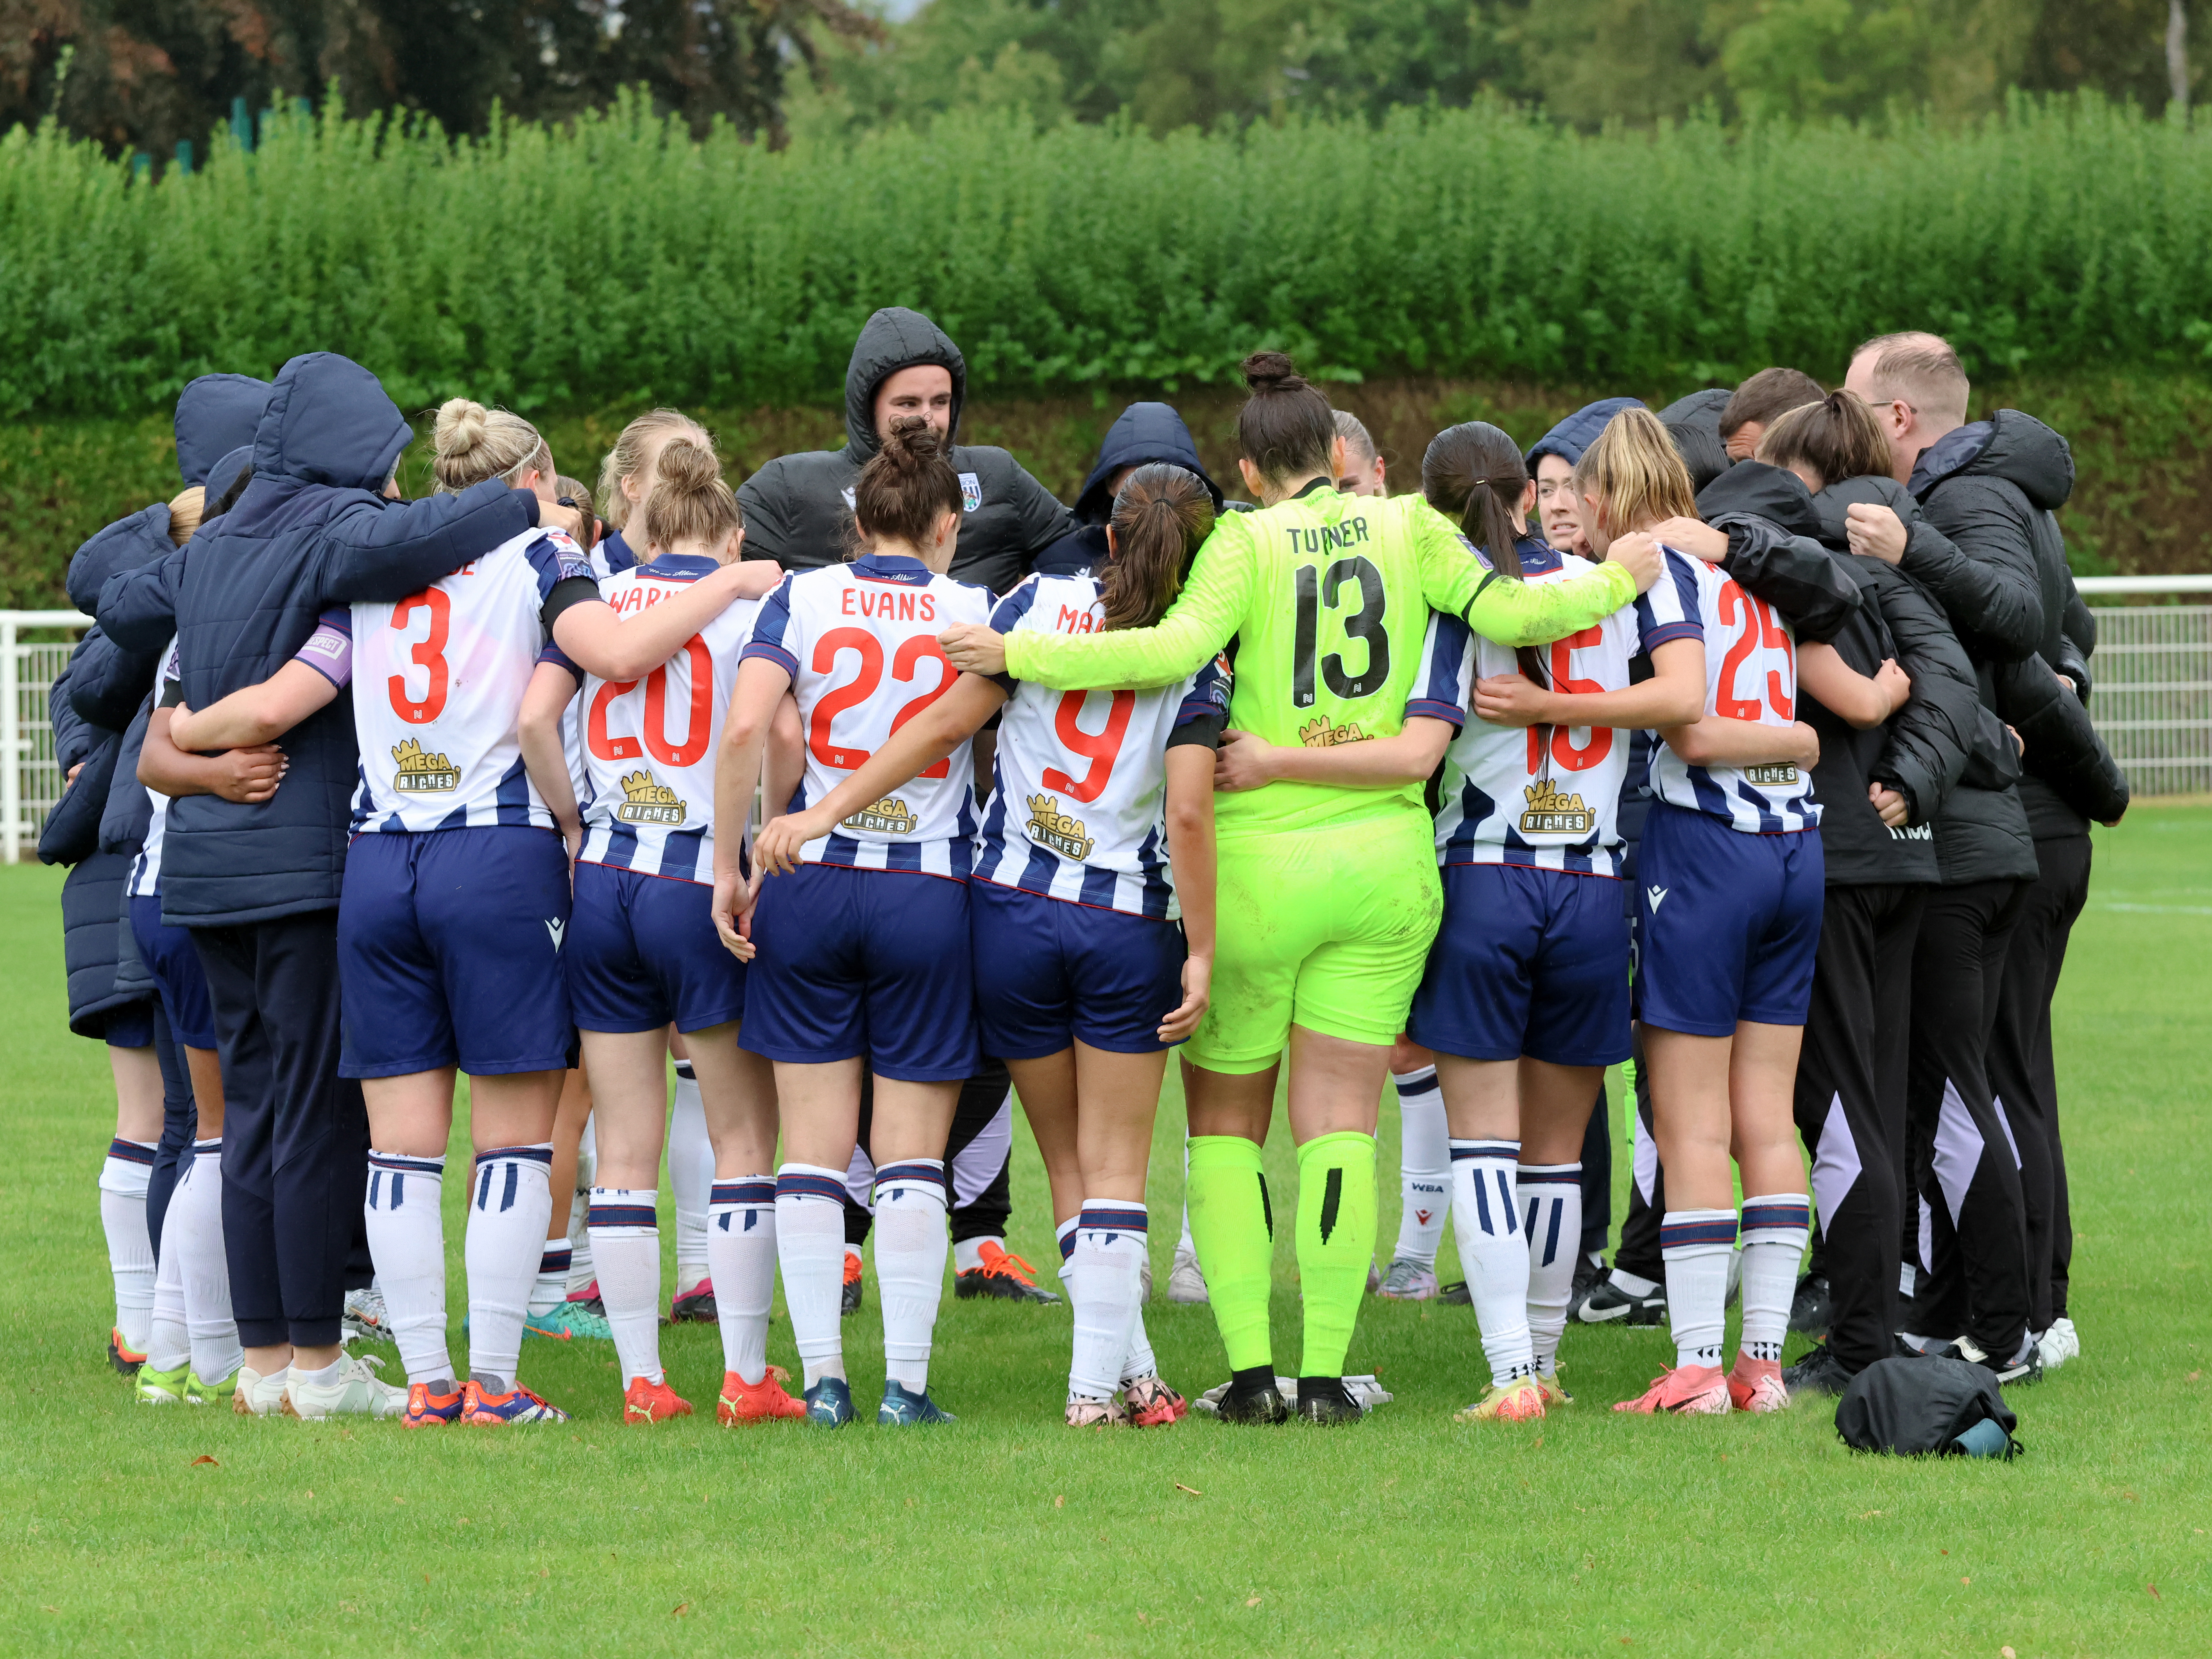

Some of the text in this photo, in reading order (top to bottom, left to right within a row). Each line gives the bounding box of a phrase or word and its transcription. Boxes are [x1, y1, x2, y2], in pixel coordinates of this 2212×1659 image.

[1286, 517, 1369, 555] TURNER
[842, 588, 935, 621] EVANS
[1293, 556, 1389, 708] 13
[307, 636, 339, 651] RESPECT
[1716, 579, 1793, 721] 25
[388, 586, 450, 724] 3
[809, 627, 957, 779] 22
[1305, 723, 1363, 747] MEGA
[1042, 690, 1135, 803] 9
[400, 753, 452, 771] MEGA
[400, 774, 453, 789] RICHES
[1749, 767, 1795, 783] RICHES
[628, 786, 678, 803] MEGA
[1529, 793, 1585, 811] MEGA
[624, 806, 679, 822] RICHES
[866, 799, 908, 817] EGA
[1034, 812, 1085, 838] MEGA
[1525, 815, 1584, 830] RICHES
[1031, 825, 1081, 856] RICHES
[1412, 1182, 1444, 1193] WBA
